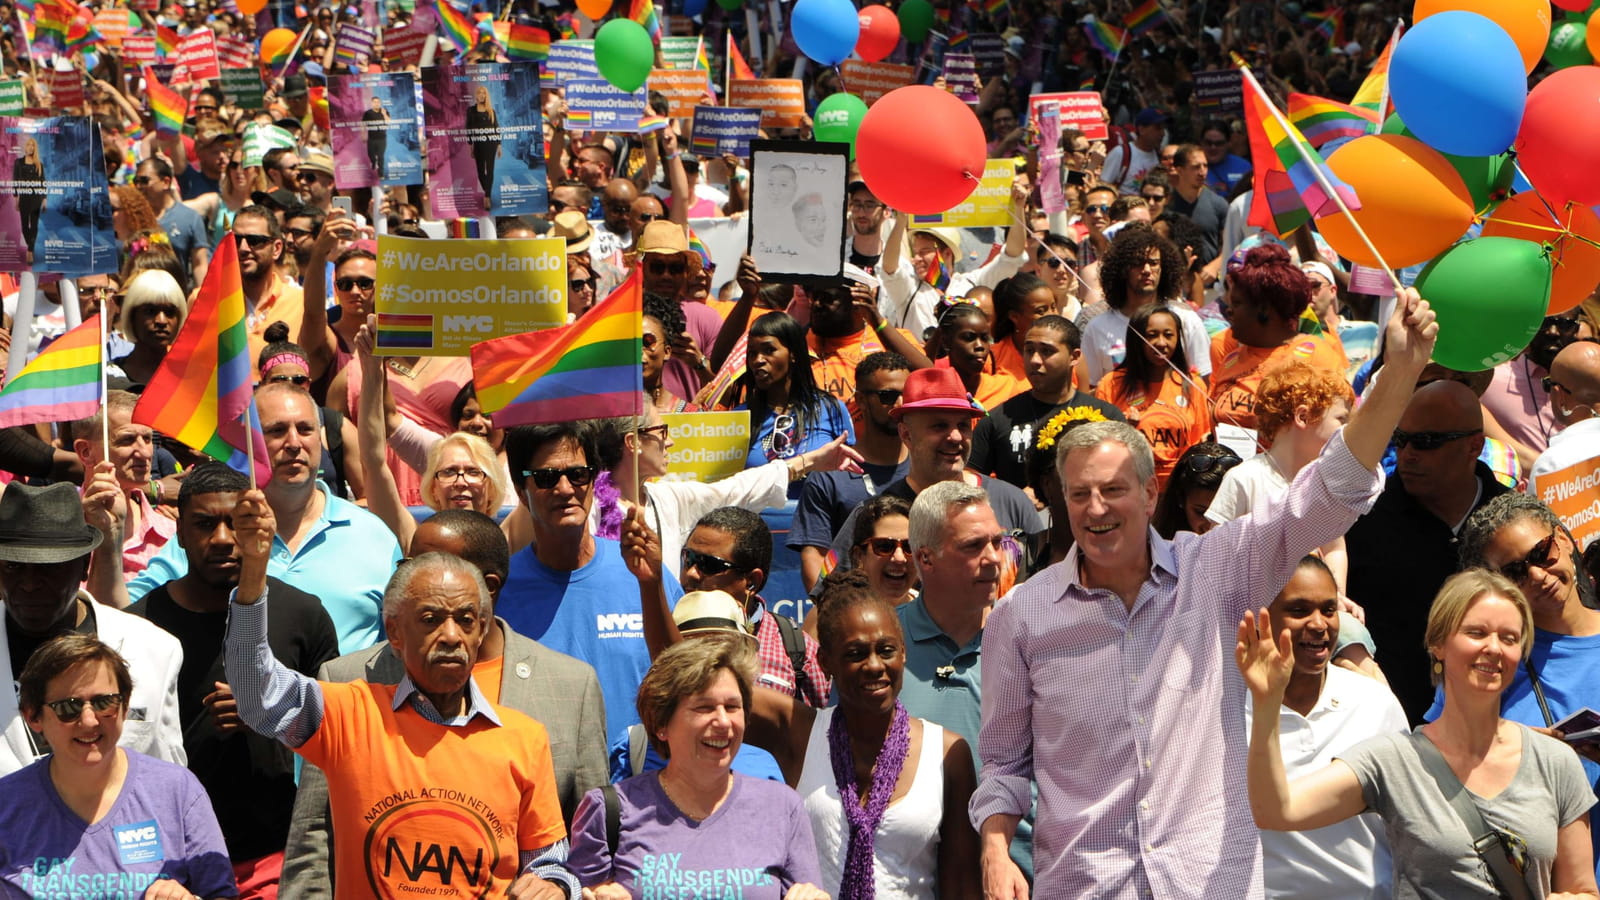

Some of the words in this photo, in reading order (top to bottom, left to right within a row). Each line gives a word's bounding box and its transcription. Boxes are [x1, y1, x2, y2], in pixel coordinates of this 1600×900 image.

[488, 73, 510, 81] BLUE
[568, 98, 645, 108] #SomosOrlando
[594, 111, 616, 120] NYC
[819, 110, 849, 123] NYC
[496, 125, 536, 134] CONSISTENT
[720, 139, 738, 148] NYC
[382, 250, 561, 271] #WeAreOrlando
[380, 284, 562, 304] #SomosOrlando
[442, 314, 493, 332] NYC
[597, 614, 643, 631] NYC
[364, 788, 418, 824] NATIONAL
[420, 787, 466, 802] ACTION
[468, 796, 504, 840] NETWORK
[118, 826, 157, 844] NYC
[33, 856, 76, 876] GAY
[384, 837, 483, 887] NAN
[643, 853, 682, 870] GAY
[398, 883, 436, 894] Founded
